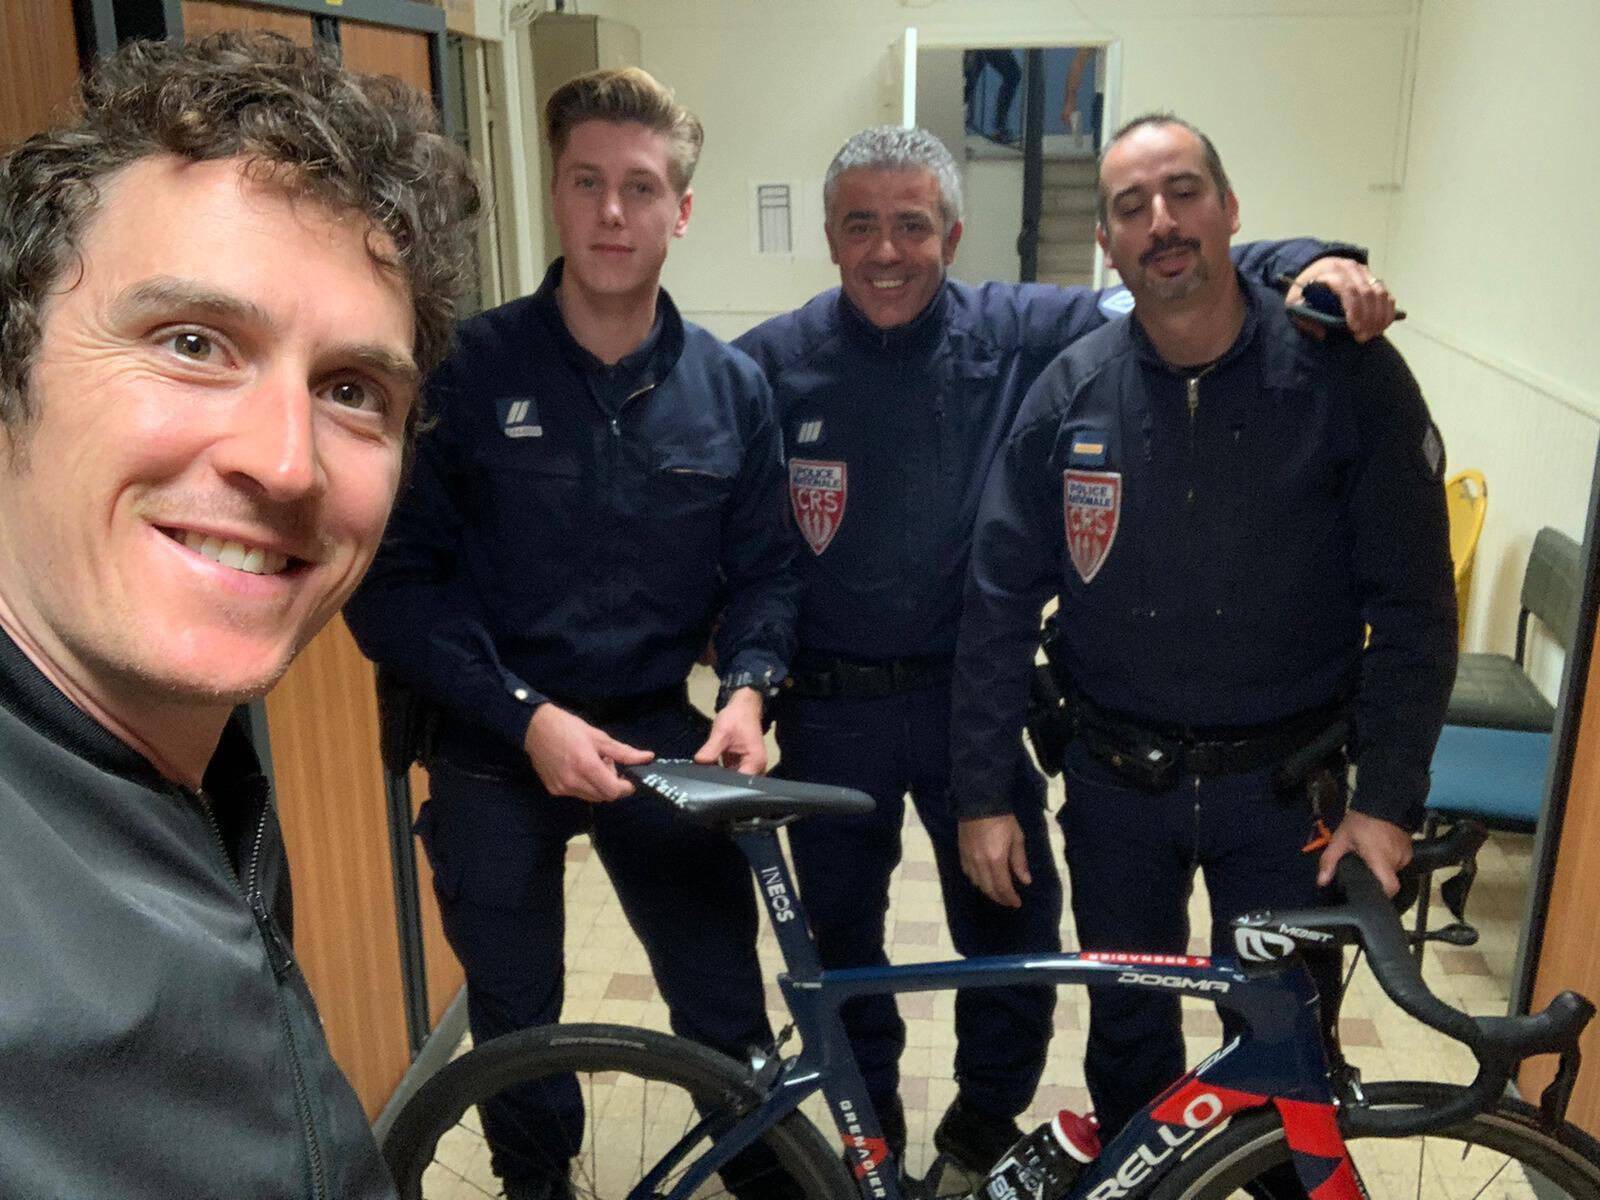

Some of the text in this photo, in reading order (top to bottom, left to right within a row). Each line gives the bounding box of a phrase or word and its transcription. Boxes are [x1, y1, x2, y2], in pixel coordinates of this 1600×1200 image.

[797, 489, 839, 513] CRS
[1069, 483, 1108, 497] POLICE
[1069, 507, 1109, 535] CRS
[761, 866, 795, 922] INEOS
[1280, 923, 1334, 942] MOST
[1118, 972, 1230, 994] DOGMA
[839, 1100, 887, 1198] GRENADIER
[1085, 1093, 1223, 1200] RELLO
